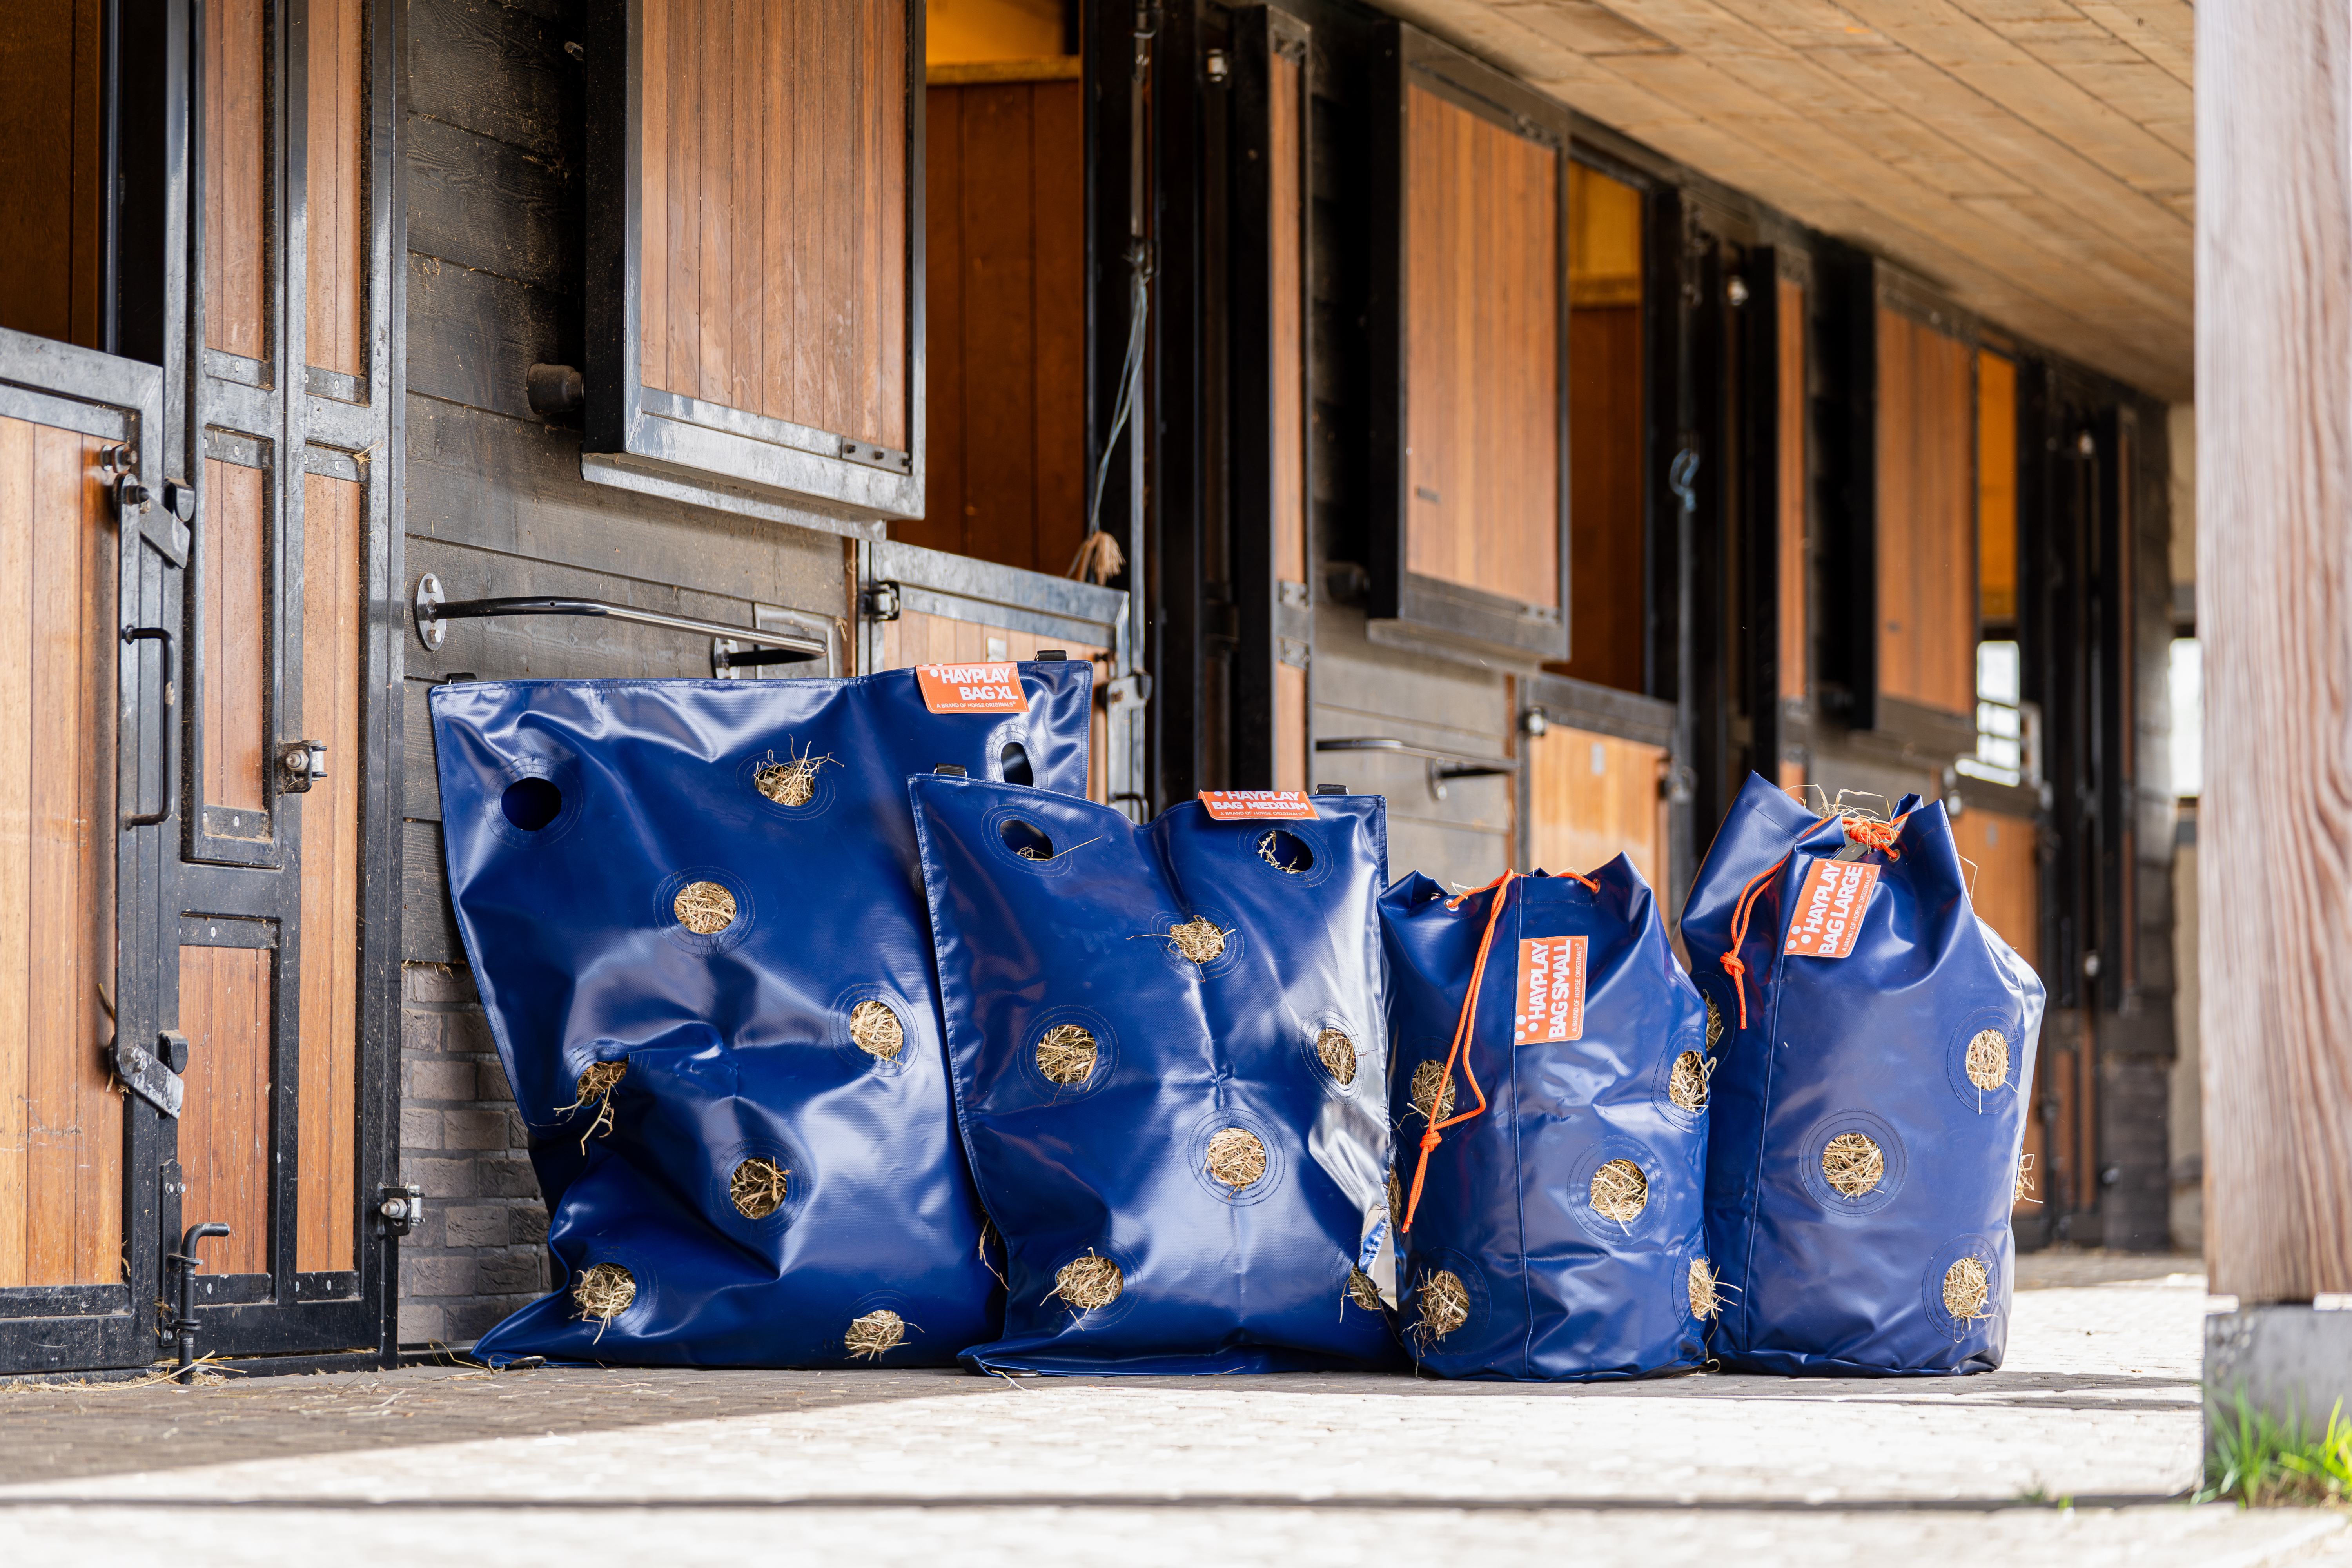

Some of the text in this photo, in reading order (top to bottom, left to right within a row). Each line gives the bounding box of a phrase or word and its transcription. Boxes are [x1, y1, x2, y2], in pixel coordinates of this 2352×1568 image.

[940, 668, 1011, 684] HAYPLAY
[959, 686, 1018, 700] BAG XL
[1211, 801, 1309, 810] BAG MEDIUM
[1226, 791, 1299, 801] HAYPLAY
[1803, 862, 1841, 933] HAYPLAY
[1818, 866, 1864, 954] BAG LARGE
[1843, 930, 1854, 948] BRAND
[1852, 903, 1863, 922] HORSE
[1528, 941, 1549, 1020] HAYPLAY
[1548, 939, 1571, 1038] BAG SMALL
